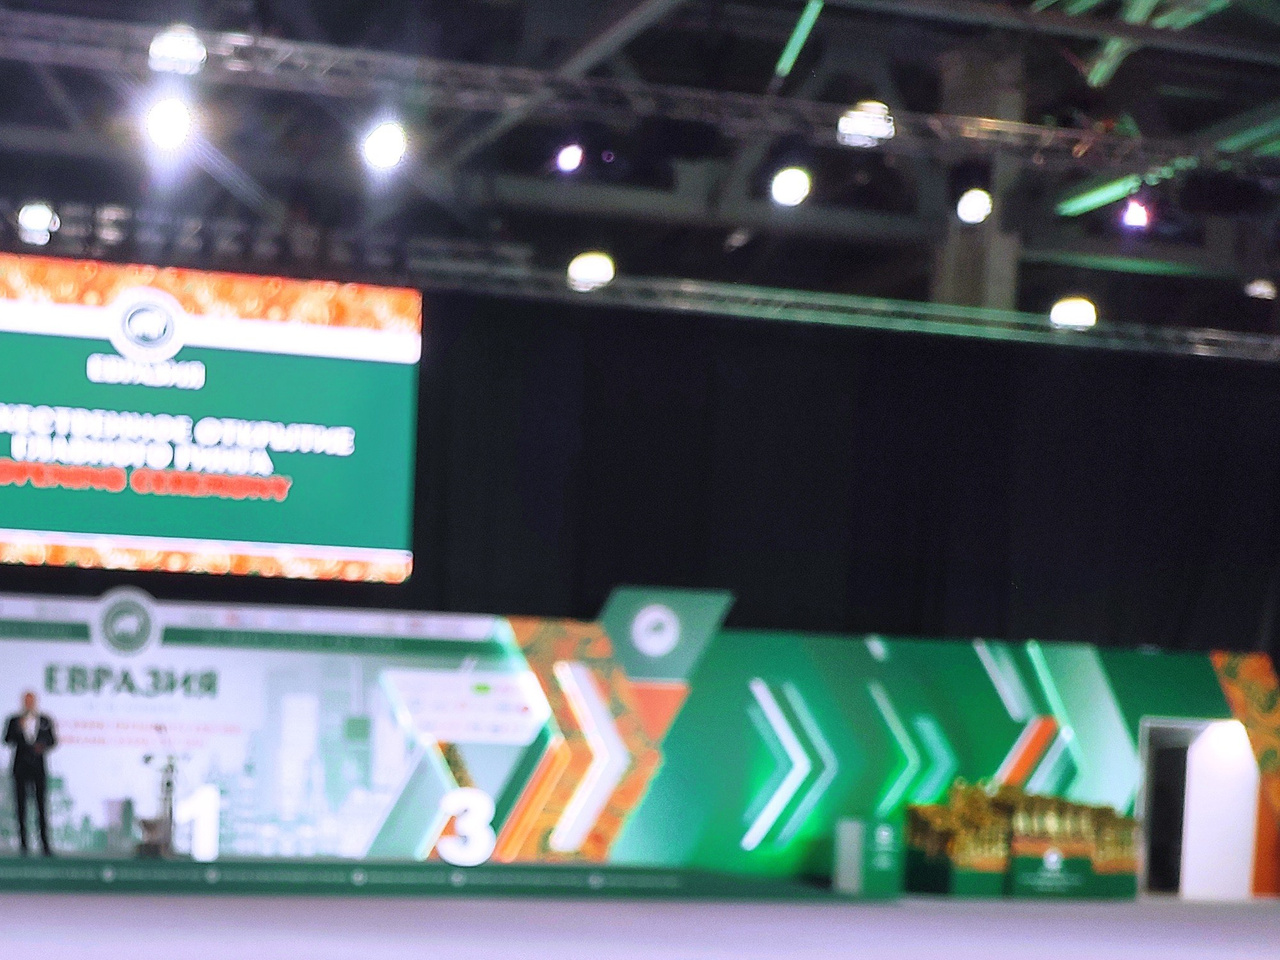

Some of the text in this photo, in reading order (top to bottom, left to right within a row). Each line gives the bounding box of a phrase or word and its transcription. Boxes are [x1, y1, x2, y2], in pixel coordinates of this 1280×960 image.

[44, 662, 217, 698] ЕВРАЗИЯ
[175, 784, 220, 862] 1
[436, 787, 497, 867] 3
